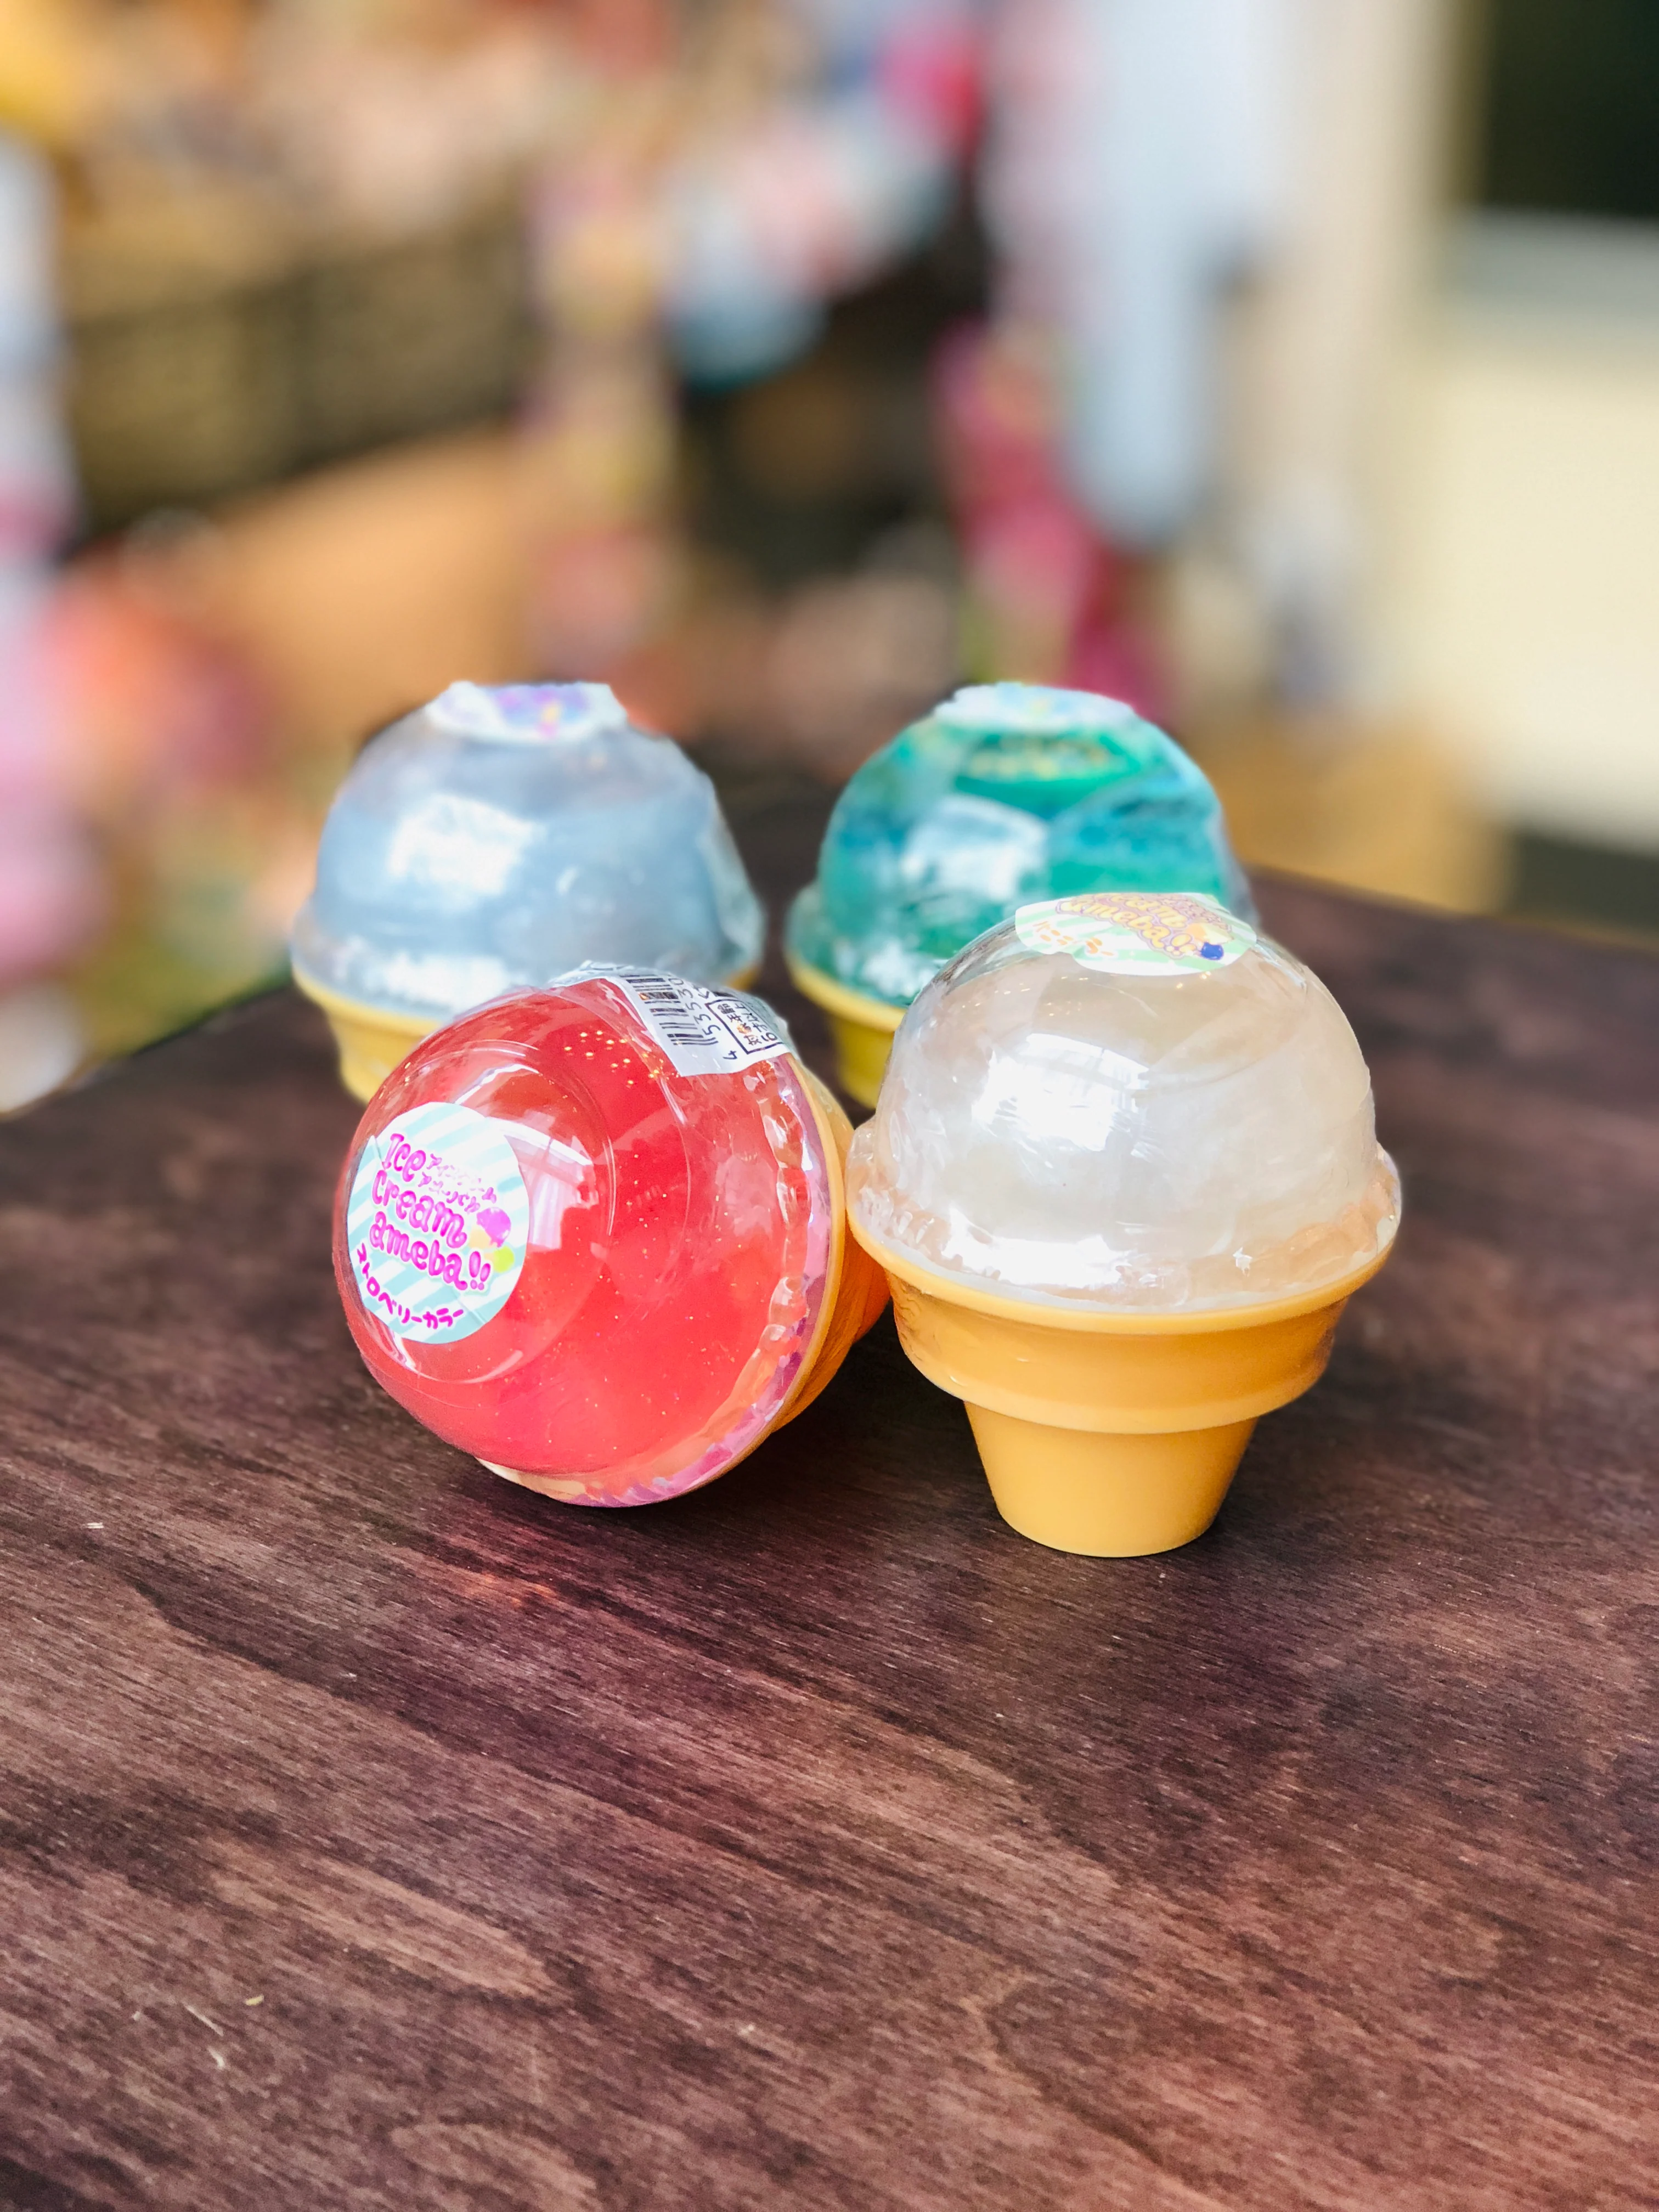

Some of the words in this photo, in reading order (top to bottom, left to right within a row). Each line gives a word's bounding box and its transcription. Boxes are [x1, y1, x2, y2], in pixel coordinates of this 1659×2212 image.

[668, 974, 722, 1036] 53530
[735, 1002, 778, 1042] 6才以上
[381, 1133, 427, 1182] Ice
[371, 1169, 467, 1249] Cream
[357, 1243, 464, 1329] ストロベリーカラー
